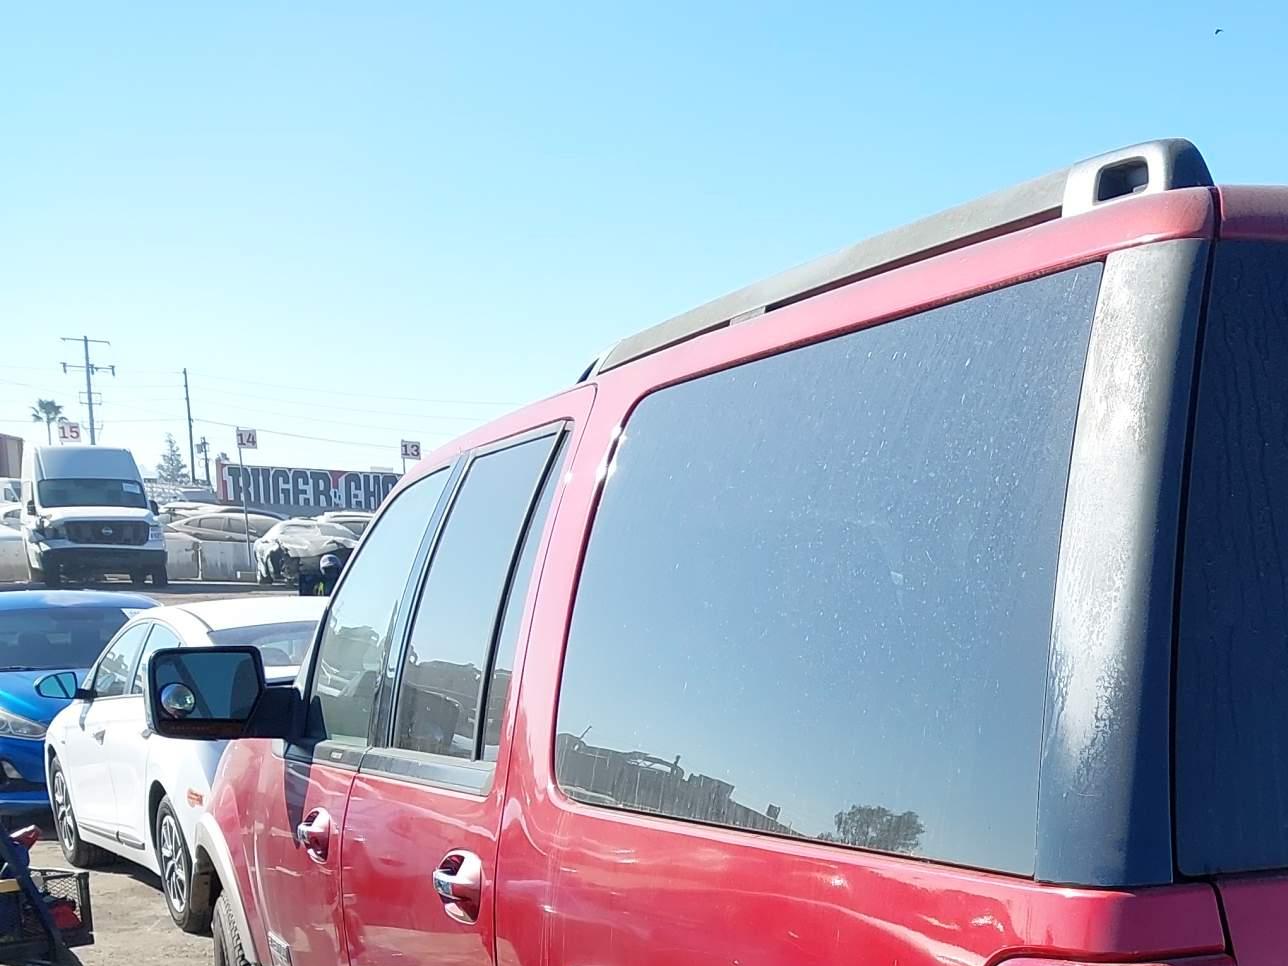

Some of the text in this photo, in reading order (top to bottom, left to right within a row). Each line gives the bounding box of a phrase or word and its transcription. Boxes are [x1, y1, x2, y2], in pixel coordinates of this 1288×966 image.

[59, 425, 80, 439] 15
[237, 433, 257, 447] 14
[402, 443, 420, 458] 13
